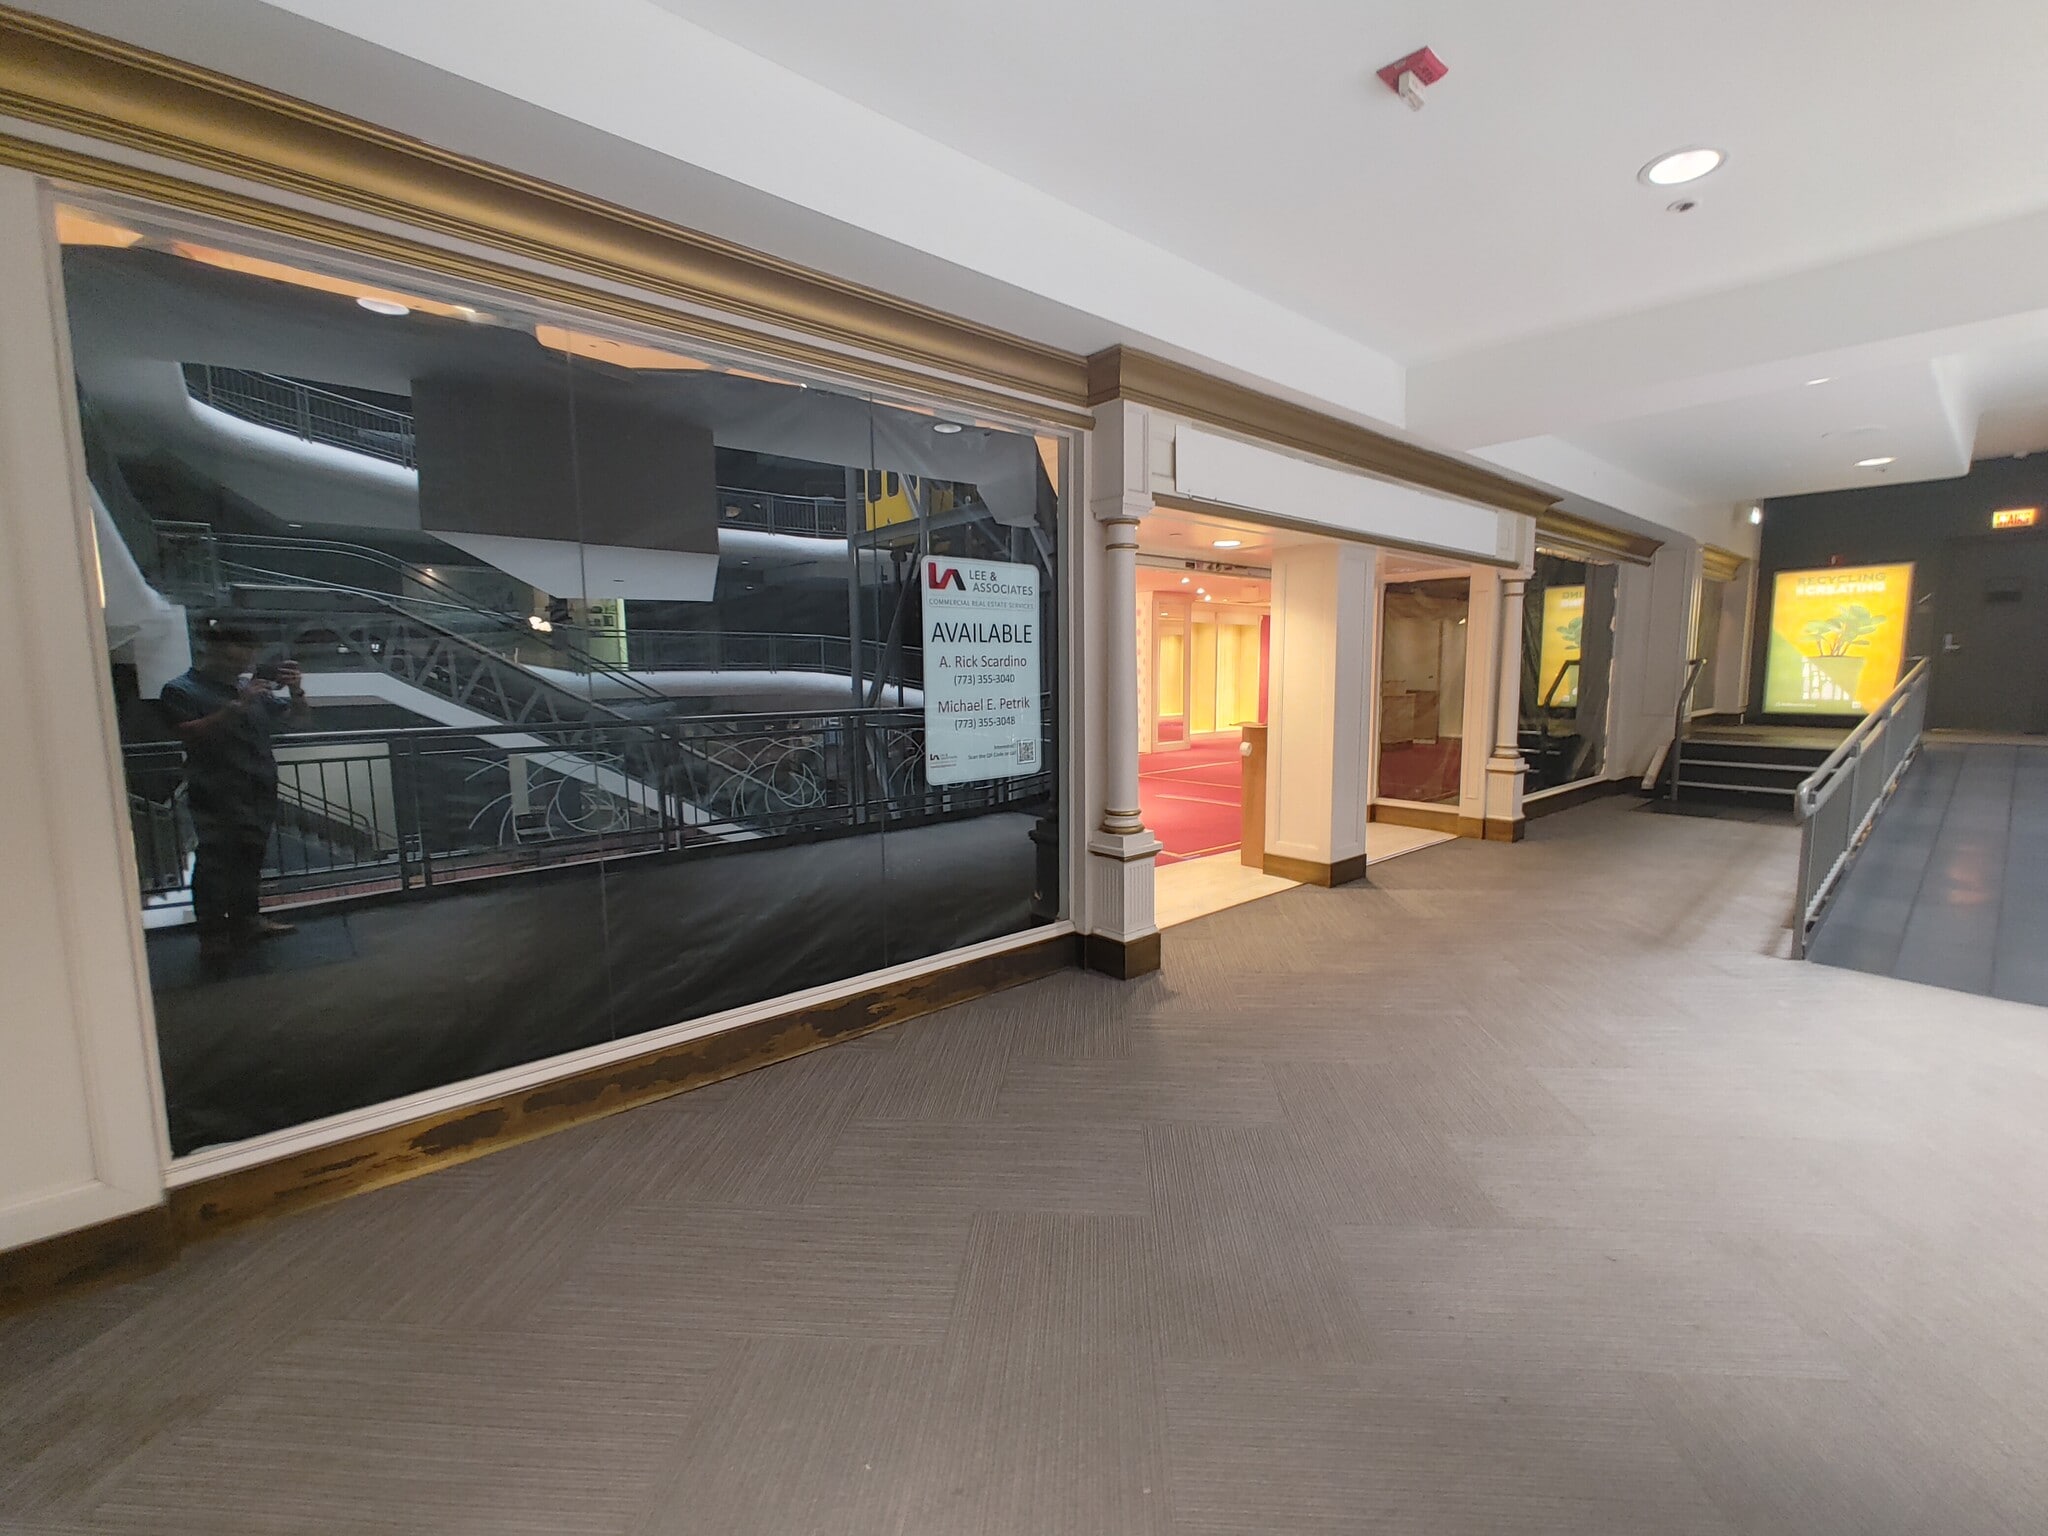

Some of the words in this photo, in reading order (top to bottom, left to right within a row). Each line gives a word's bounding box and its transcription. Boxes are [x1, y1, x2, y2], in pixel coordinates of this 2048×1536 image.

[969, 570, 986, 580] LEE
[990, 571, 997, 581] &
[1798, 572, 1887, 586] RECYCLING
[972, 582, 1034, 596] ASSOCIATES
[929, 599, 970, 607] COMMERCIAL
[988, 600, 1007, 608] ESTATE
[931, 622, 1033, 643] AVAILABLE
[939, 656, 951, 668] A.
[955, 655, 978, 668] Rick
[981, 655, 1027, 668] Scardino
[954, 674, 975, 686] (773)
[978, 674, 1015, 684] 355-3040
[938, 698, 983, 713] Michael
[987, 699, 996, 711] E.
[999, 696, 1030, 710] Petrik
[954, 718, 976, 731] (773)
[978, 716, 1016, 728] 355-3048
